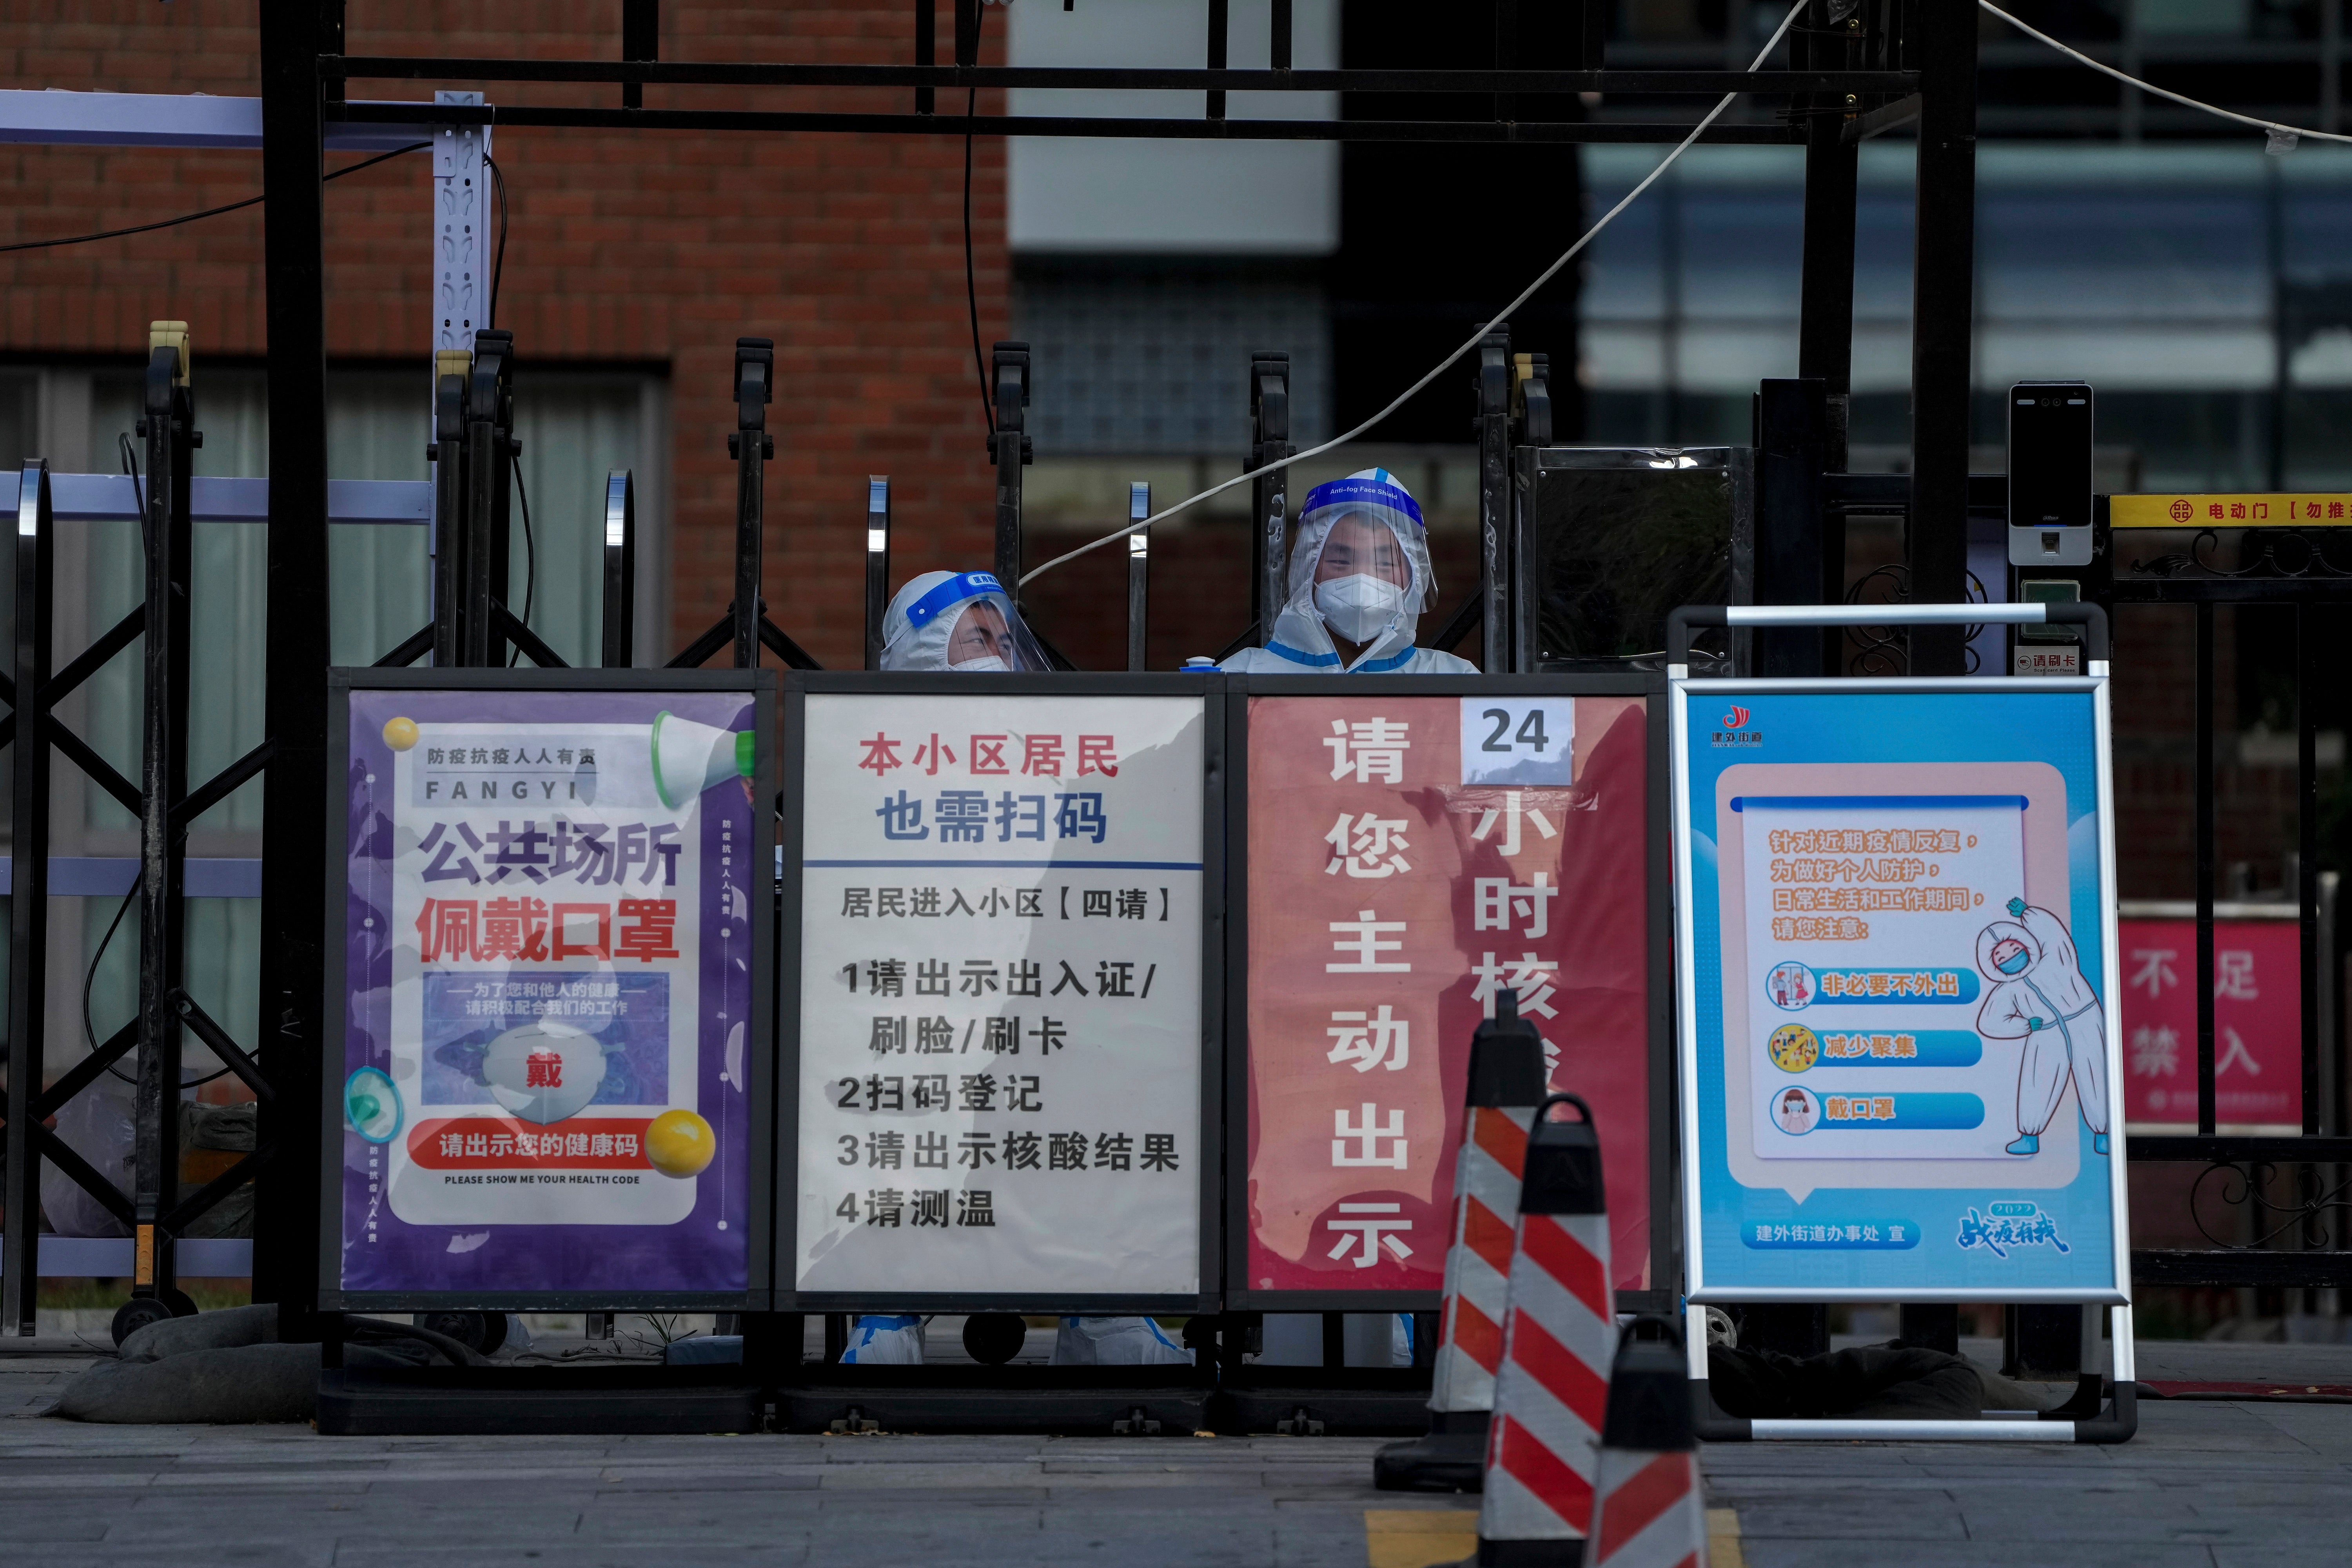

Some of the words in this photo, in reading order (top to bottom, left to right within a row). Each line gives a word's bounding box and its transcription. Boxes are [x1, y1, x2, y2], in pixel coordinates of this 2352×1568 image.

[1330, 486, 1358, 495] Anti-fog
[1377, 488, 1397, 500] Shield
[2209, 501, 2352, 519] 电动门【勿推
[2034, 655, 2075, 666] 请刷卡
[1481, 708, 1549, 753] 24
[1712, 731, 1762, 742] 建外街道
[427, 748, 596, 765] 防疫抗疫人人有责
[858, 732, 1118, 778] 本小区居民
[426, 780, 576, 800] FANGYI
[875, 789, 1107, 844] 也需扫码
[418, 820, 681, 886] 公共场所
[1768, 829, 1978, 853] 针对近期疫情反复，
[721, 819, 731, 916] 防疫抗疫人人有责
[1771, 858, 1939, 883] 为做好个人防护，
[840, 887, 1169, 921] 居民进入小区【四请】
[1772, 887, 1984, 912] 日常生活和工作期间，
[415, 897, 679, 963] 佩戴口罩
[1471, 791, 1562, 1098] 小时核
[475, 982, 619, 999] 为了您和他人的健康
[842, 958, 1156, 998] 1请出示出入证/
[1821, 973, 1959, 997] 非必要不外出
[1323, 717, 1414, 1269] 请您主动出示
[466, 1000, 628, 1016] 请积极配合我们的工作
[868, 1016, 1067, 1055] 刷脸/刷卡
[1824, 1034, 1918, 1058] 减少聚集
[526, 1053, 562, 1088] 戴
[837, 1073, 1043, 1112] 2扫码登记
[1826, 1096, 1896, 1120] 戴口罩
[439, 1133, 638, 1158] 请出示您的健康码
[837, 1131, 1180, 1172] 3请出示核酸结果
[445, 1175, 483, 1185] PLEASE
[486, 1175, 517, 1185] SHOW
[520, 1175, 534, 1185] ME
[537, 1175, 566, 1185] YOUR
[569, 1175, 609, 1185] HEALTH
[612, 1175, 640, 1185] CODE
[368, 1146, 379, 1242] 防疫抗疫人人有责
[836, 1188, 996, 1228] 4请测温
[1996, 1205, 2031, 1214] 2022
[1756, 1225, 1879, 1243] 建外街道办事处
[1888, 1225, 1906, 1242] 宣
[1958, 1208, 2070, 1258] 战疫有我
